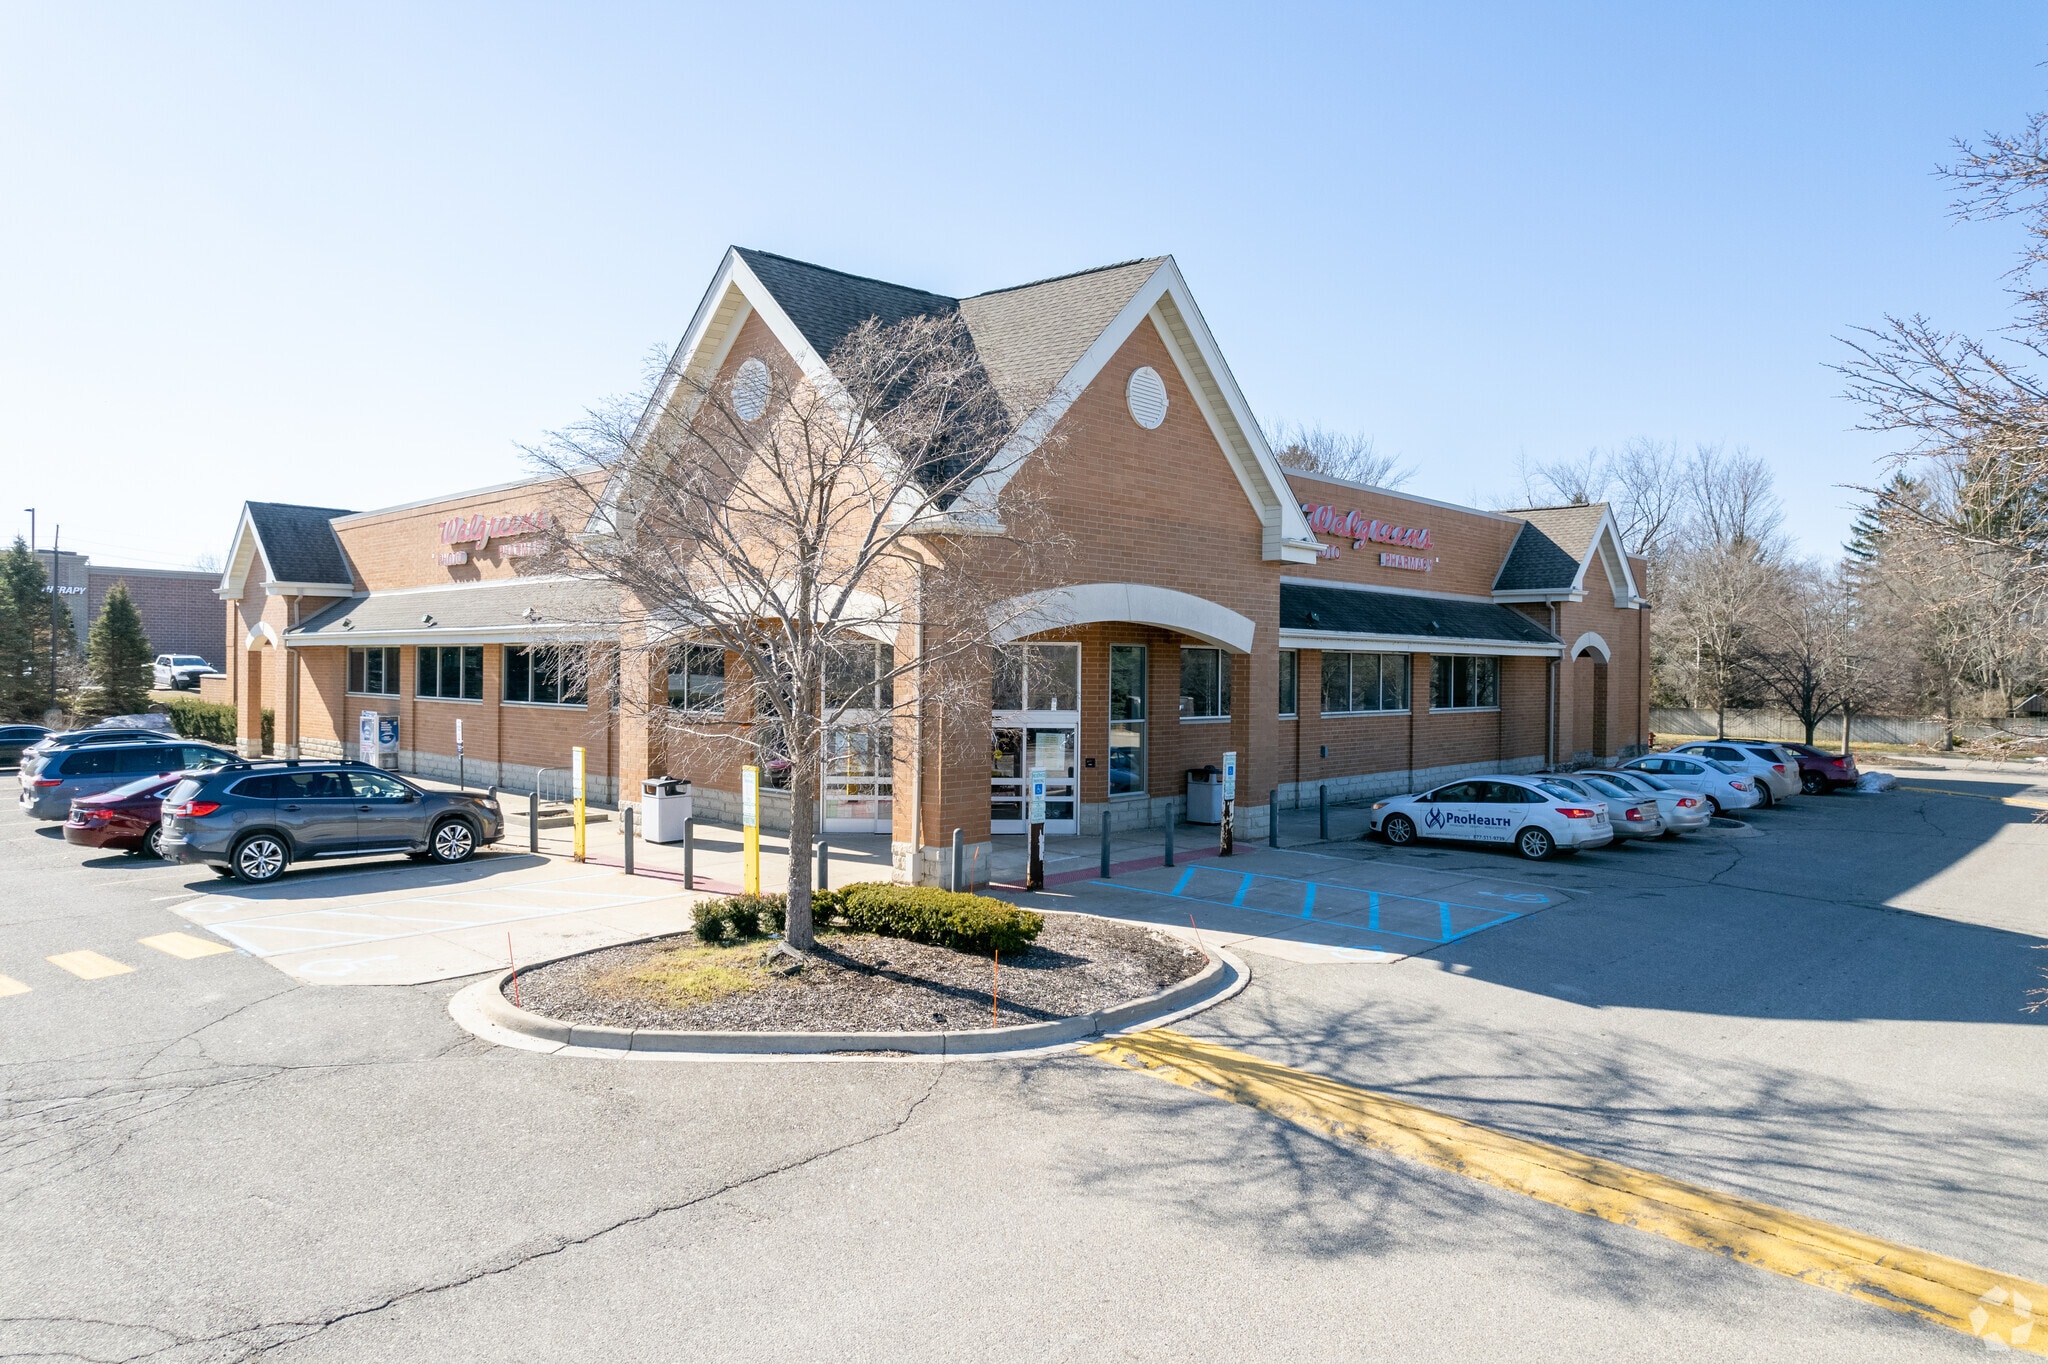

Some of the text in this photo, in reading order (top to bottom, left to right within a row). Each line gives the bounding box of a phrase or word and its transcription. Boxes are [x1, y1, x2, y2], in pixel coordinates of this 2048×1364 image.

[438, 509, 553, 550] Walgreens
[1302, 503, 1433, 550] Walgreens
[1381, 552, 1433, 571] PHARMACY
